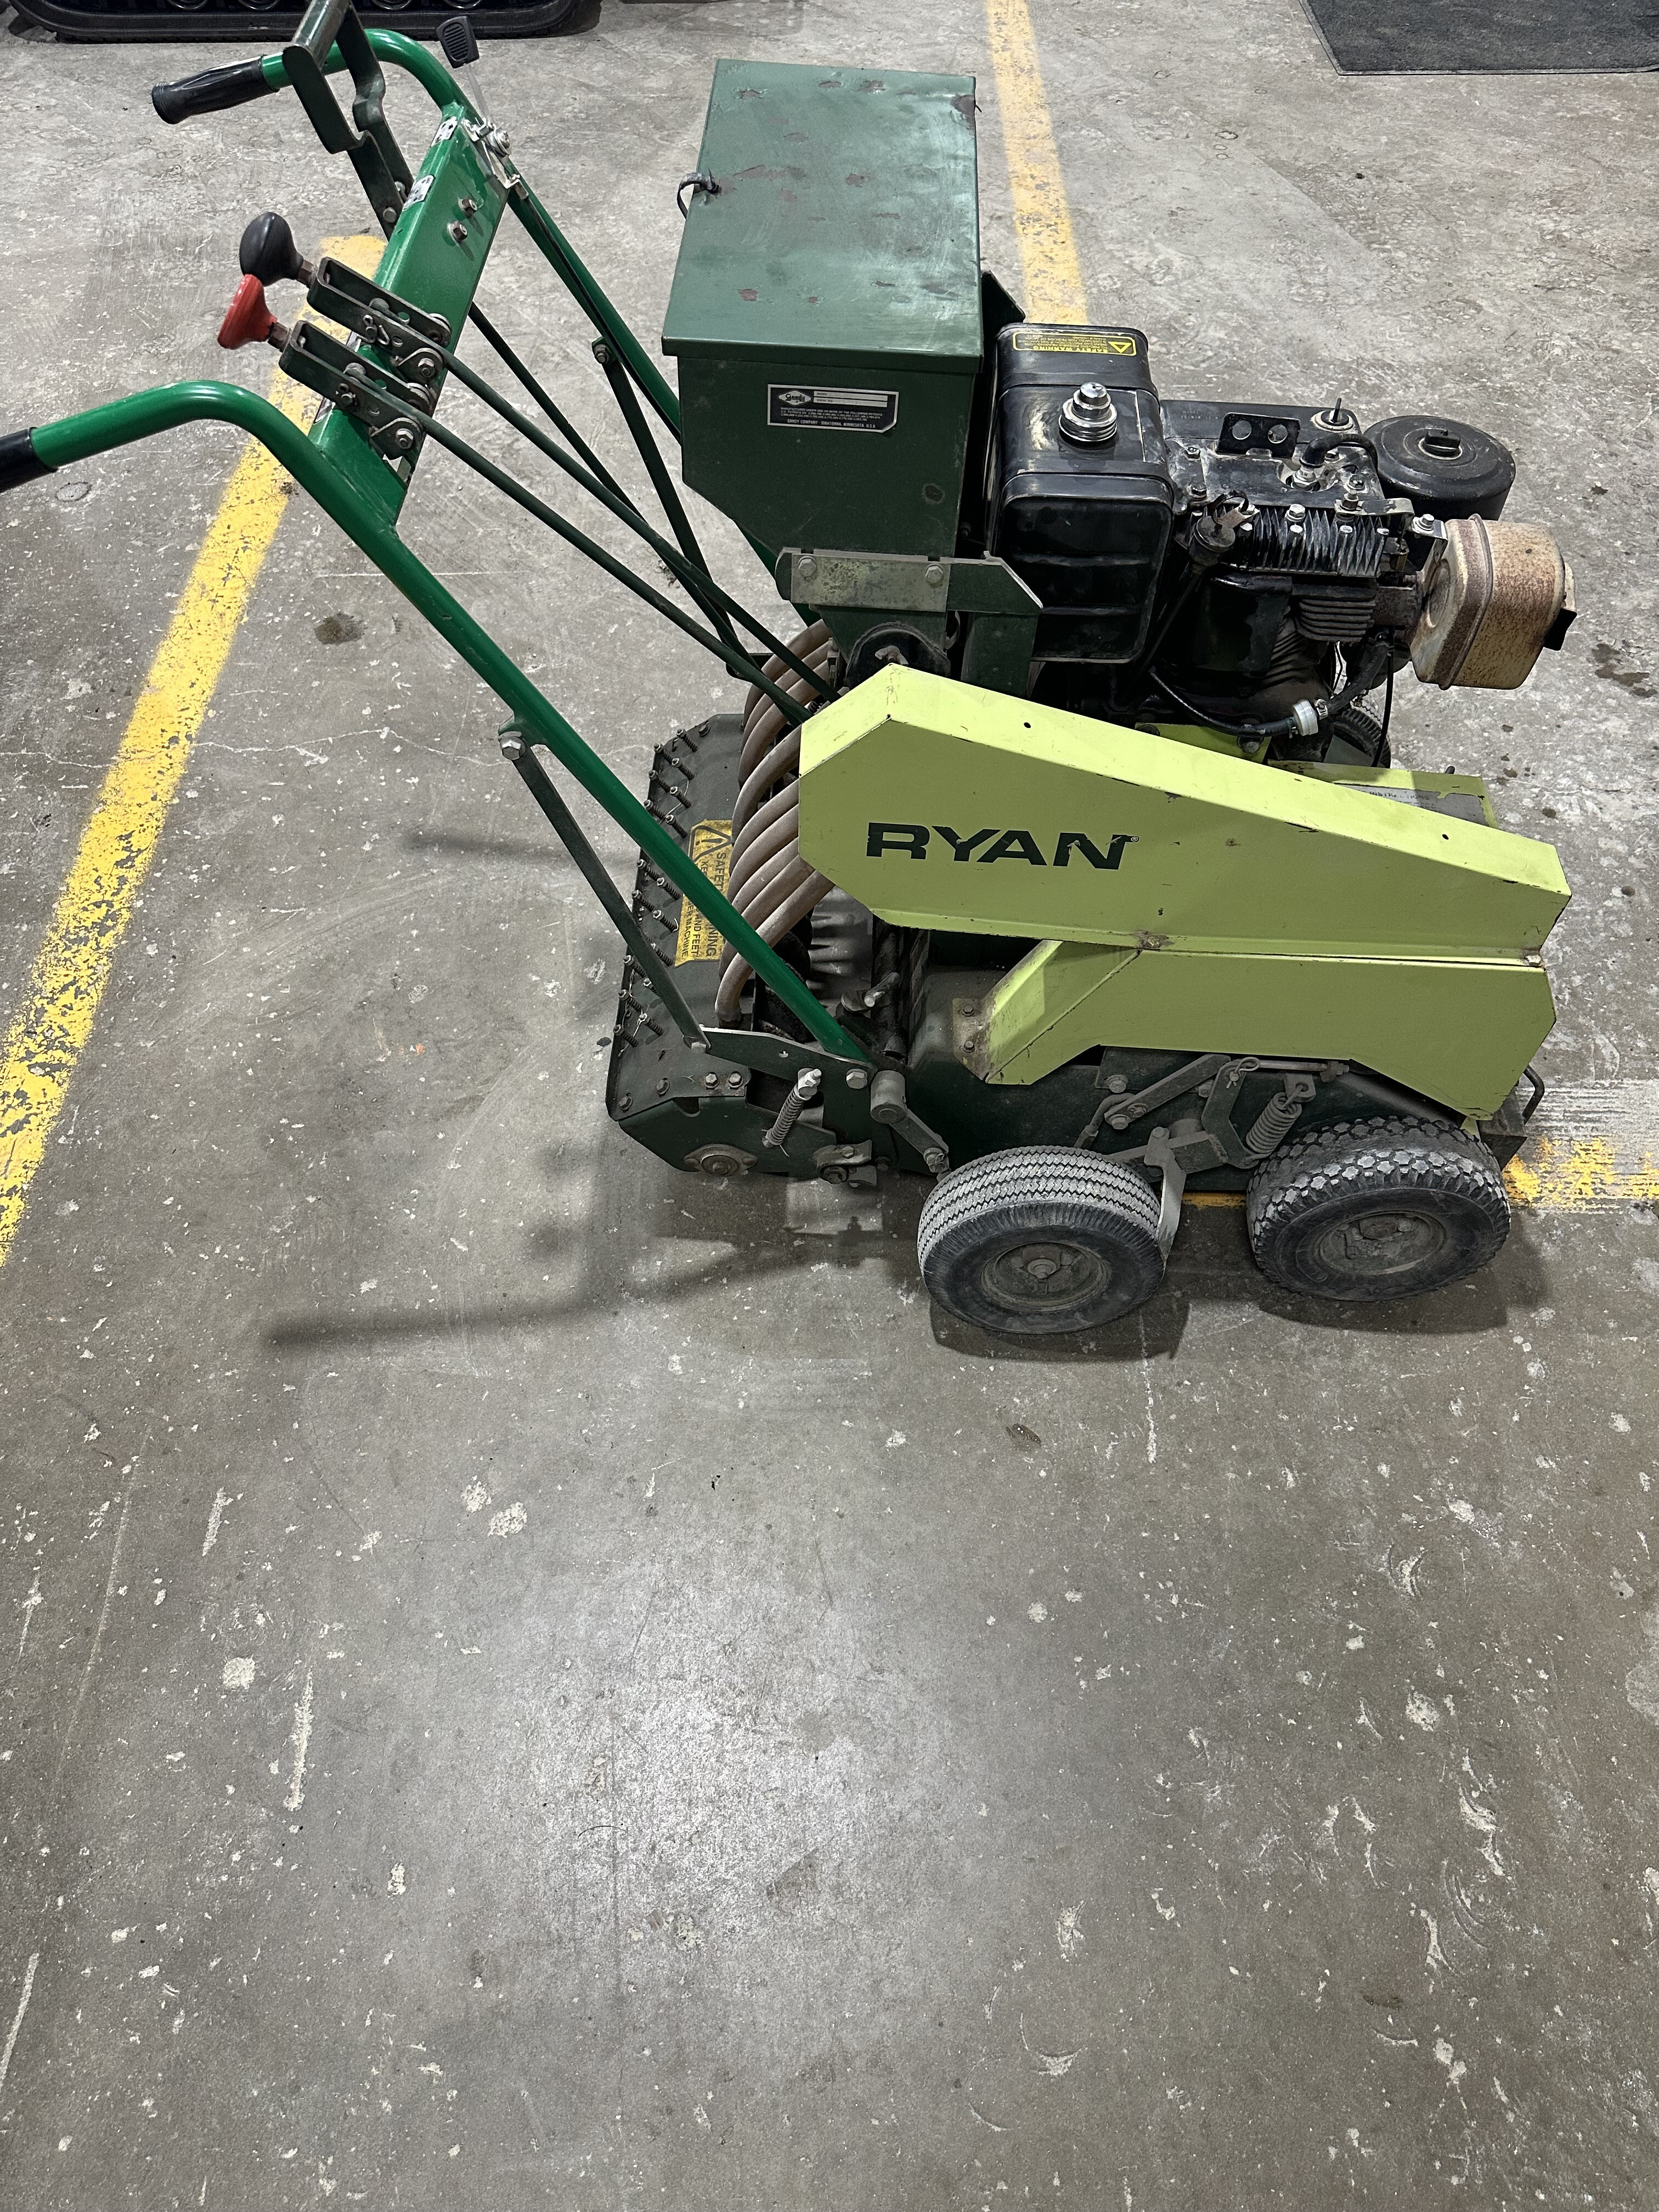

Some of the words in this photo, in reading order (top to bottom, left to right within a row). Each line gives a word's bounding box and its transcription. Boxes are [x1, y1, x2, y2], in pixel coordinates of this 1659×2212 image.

[693, 914, 702, 932] AND
[691, 934, 701, 955] FEET
[706, 924, 719, 957] NING
